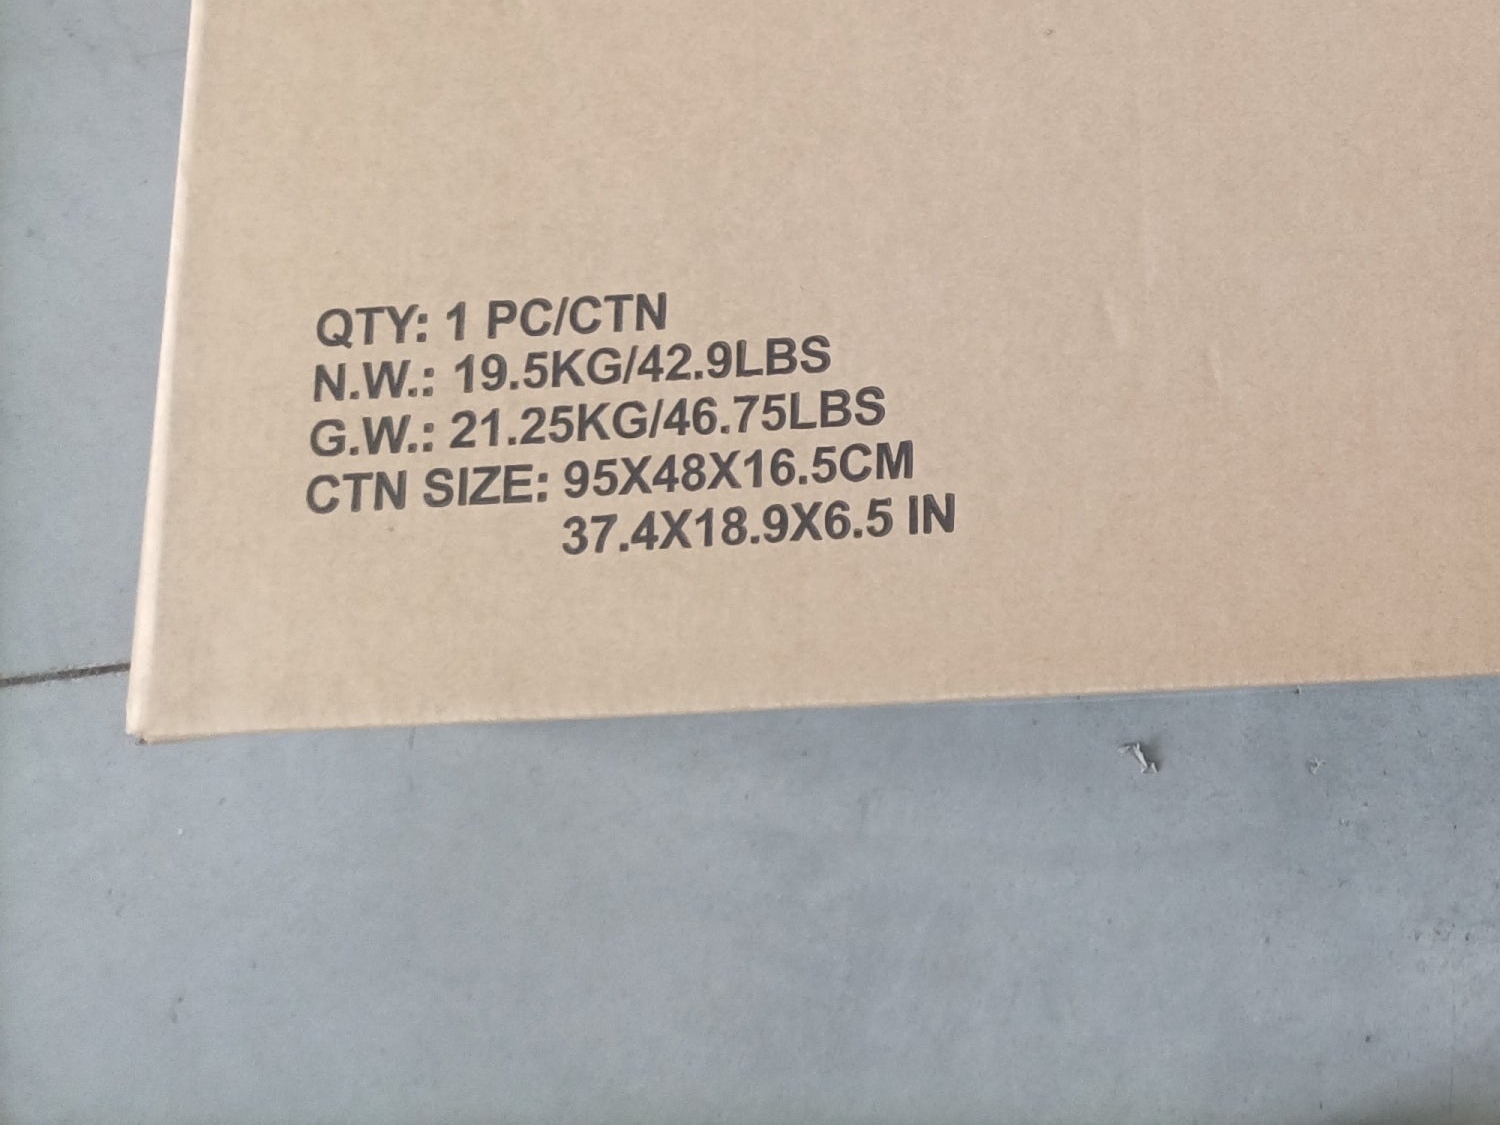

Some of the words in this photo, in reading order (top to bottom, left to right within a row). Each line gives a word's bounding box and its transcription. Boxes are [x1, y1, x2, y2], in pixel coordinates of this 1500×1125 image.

[317, 304, 427, 348] QTY:
[447, 302, 466, 341] 1
[488, 292, 667, 339] PC/CTN
[314, 359, 434, 402] N.W.:
[455, 335, 831, 393] 19.5KG/42.9LBS
[310, 414, 434, 456] G.W.:
[450, 386, 885, 448] 21.25KG/46.75LBS
[306, 470, 406, 514] CTN
[424, 463, 548, 508] SIZE:
[563, 440, 913, 499] 95X48X16.5CM
[563, 498, 893, 555] 37.4X18.9X6.5
[909, 493, 955, 536] IN
